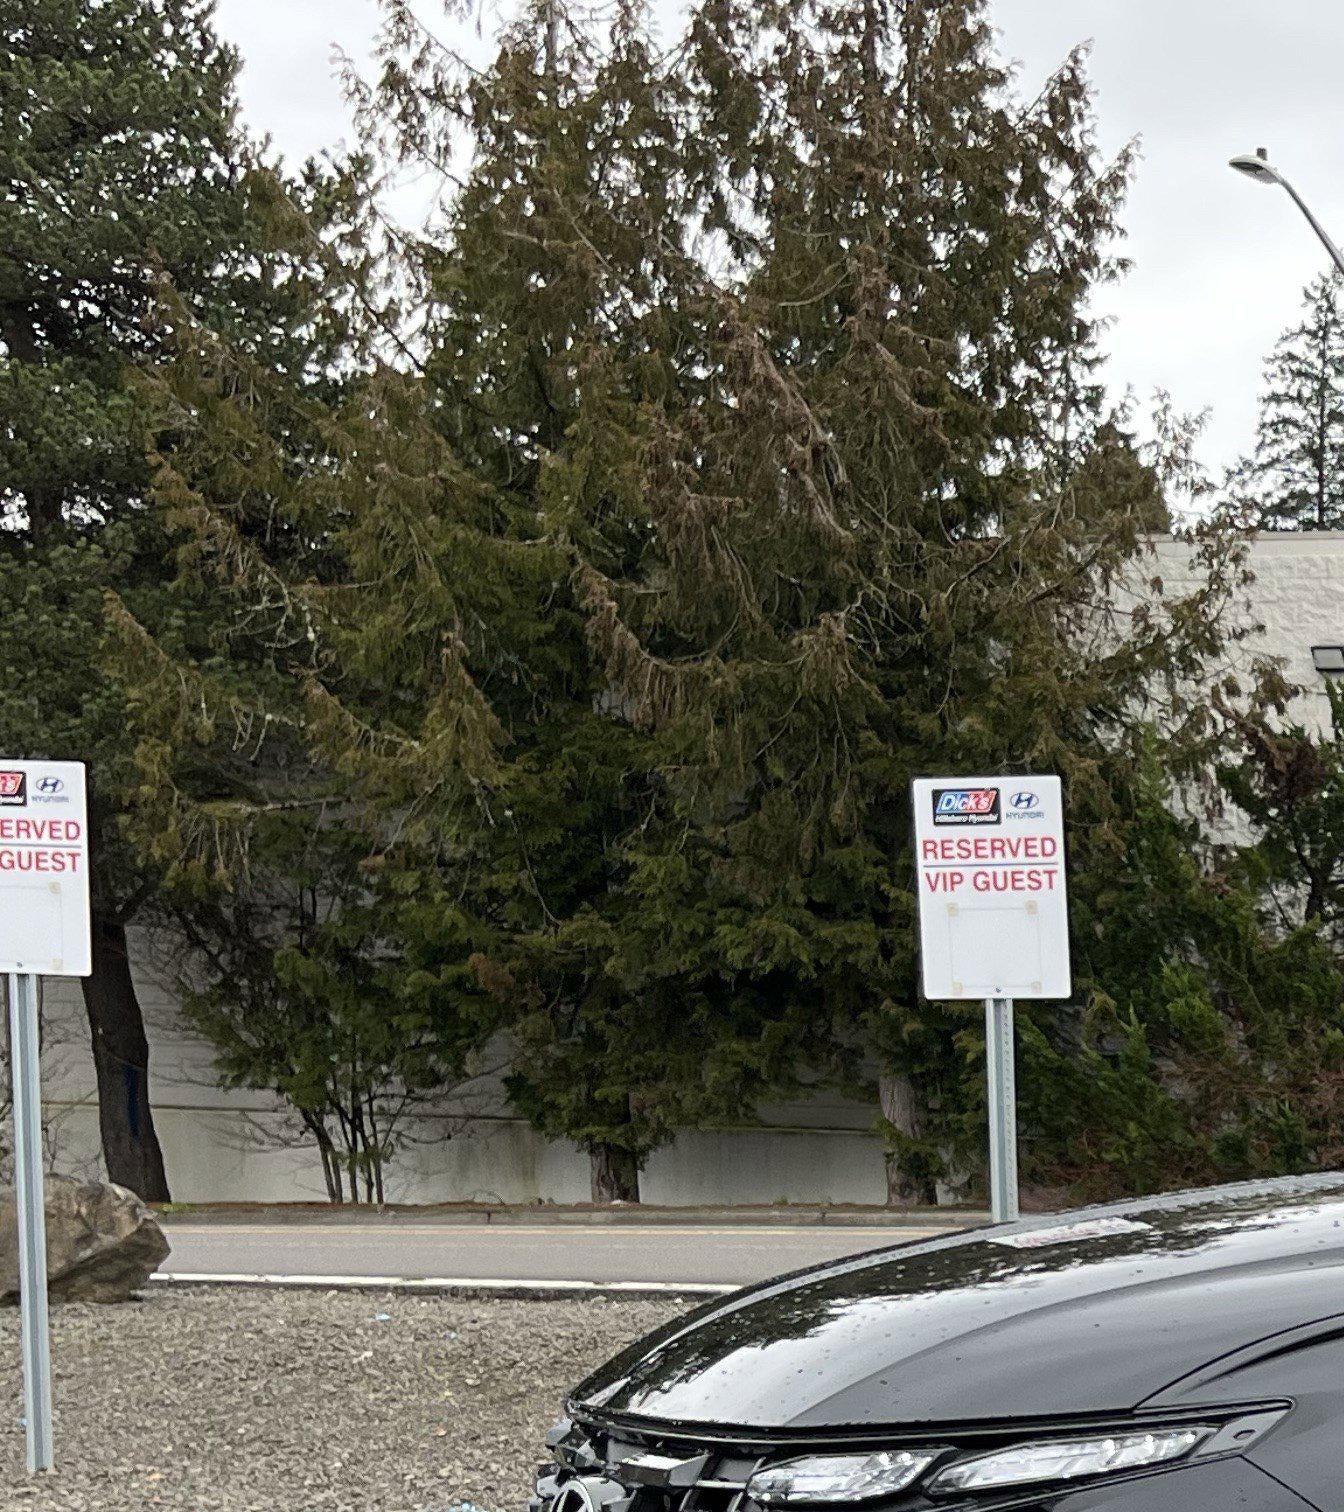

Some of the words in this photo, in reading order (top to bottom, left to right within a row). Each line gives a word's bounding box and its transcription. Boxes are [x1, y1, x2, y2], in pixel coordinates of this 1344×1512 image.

[922, 836, 1058, 860] RESERVED
[925, 871, 964, 893] VIP
[973, 868, 1058, 892] GUEST
